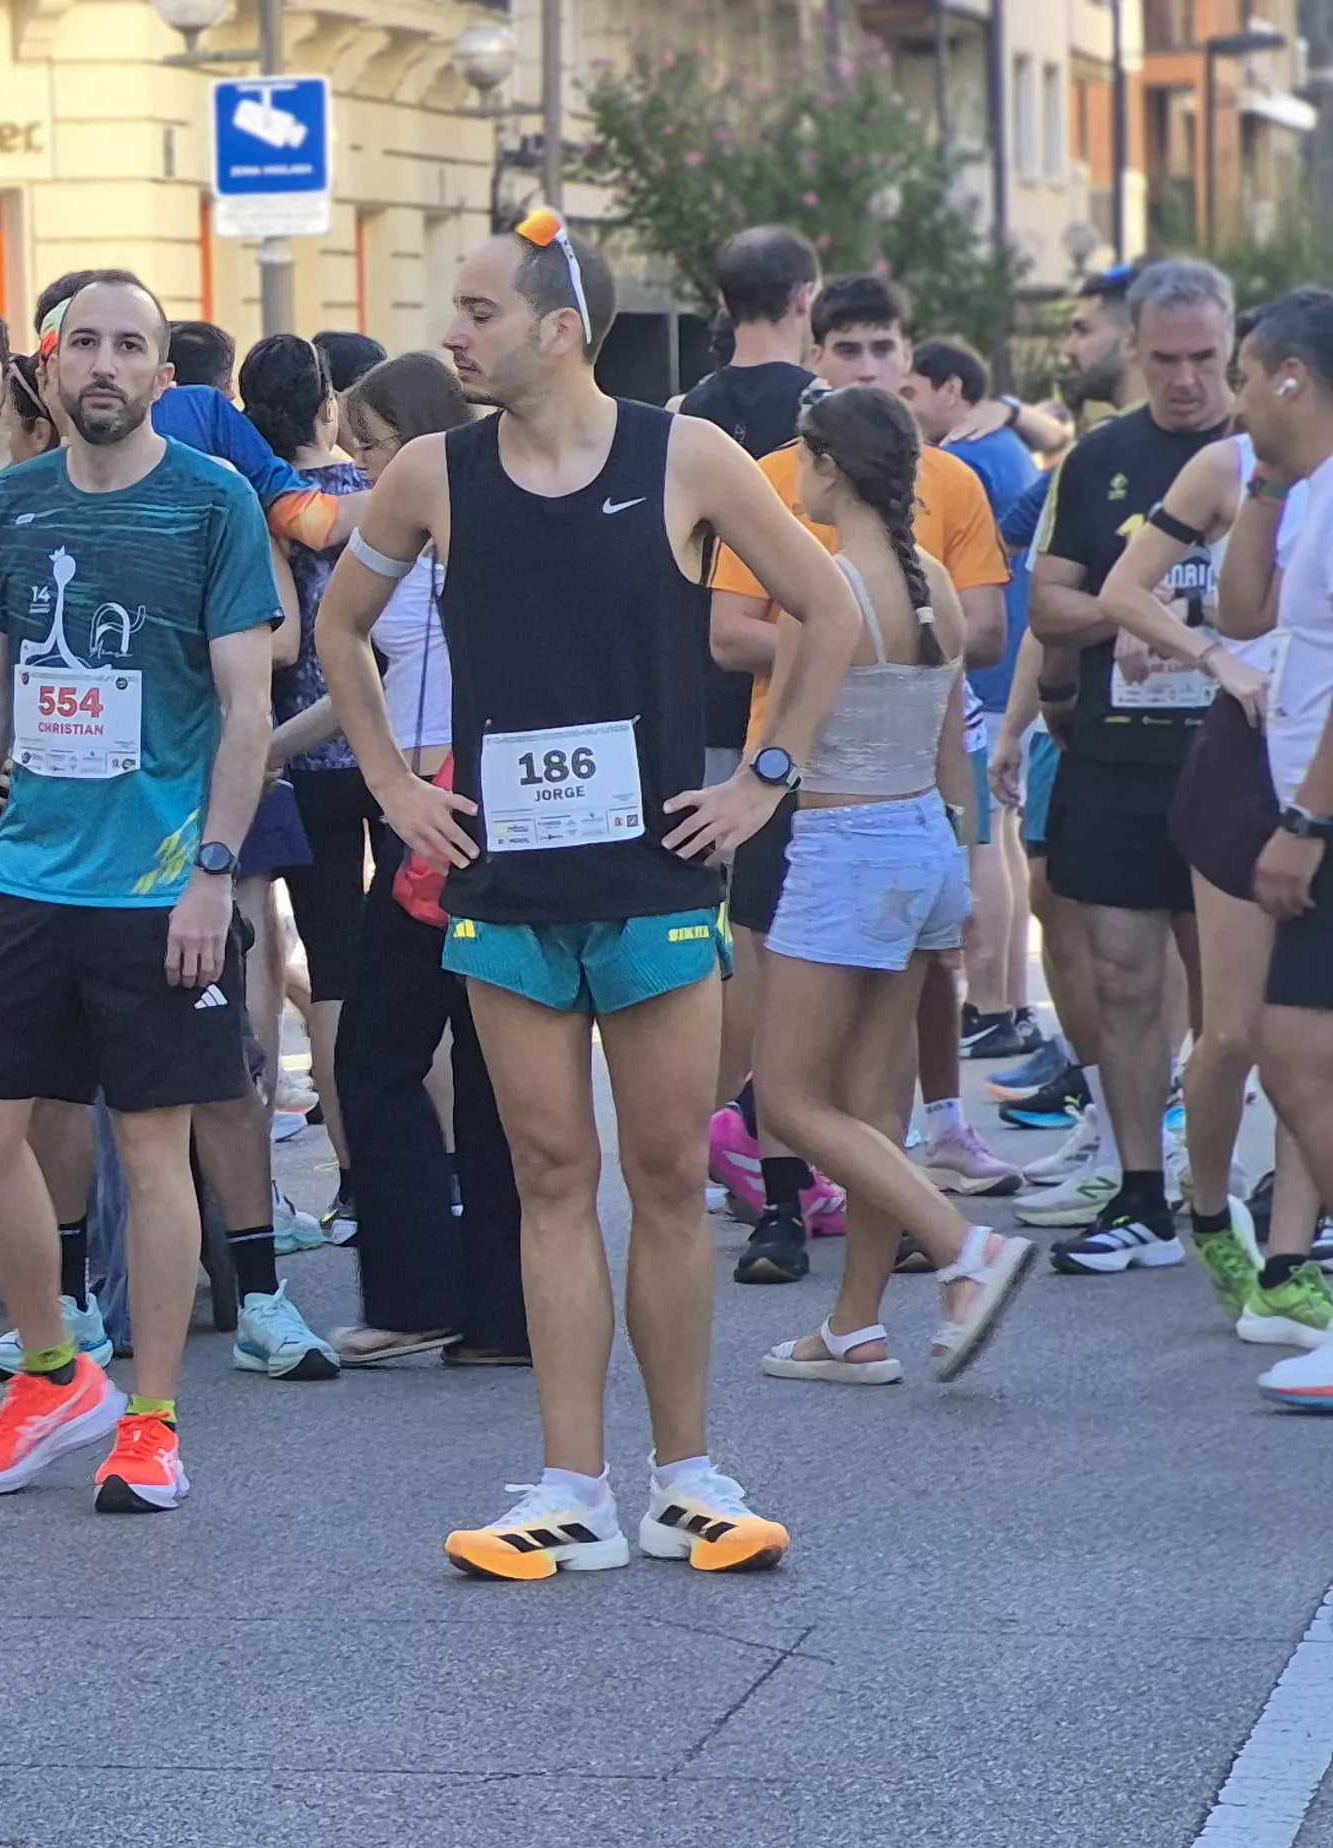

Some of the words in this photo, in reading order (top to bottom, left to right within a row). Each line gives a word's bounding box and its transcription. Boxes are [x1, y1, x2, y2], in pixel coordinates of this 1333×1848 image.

[31, 585, 51, 602] 14
[38, 685, 104, 719] 554
[38, 722, 104, 735] CHRISTIAN
[519, 747, 597, 786] 186
[534, 785, 586, 802] JORGE
